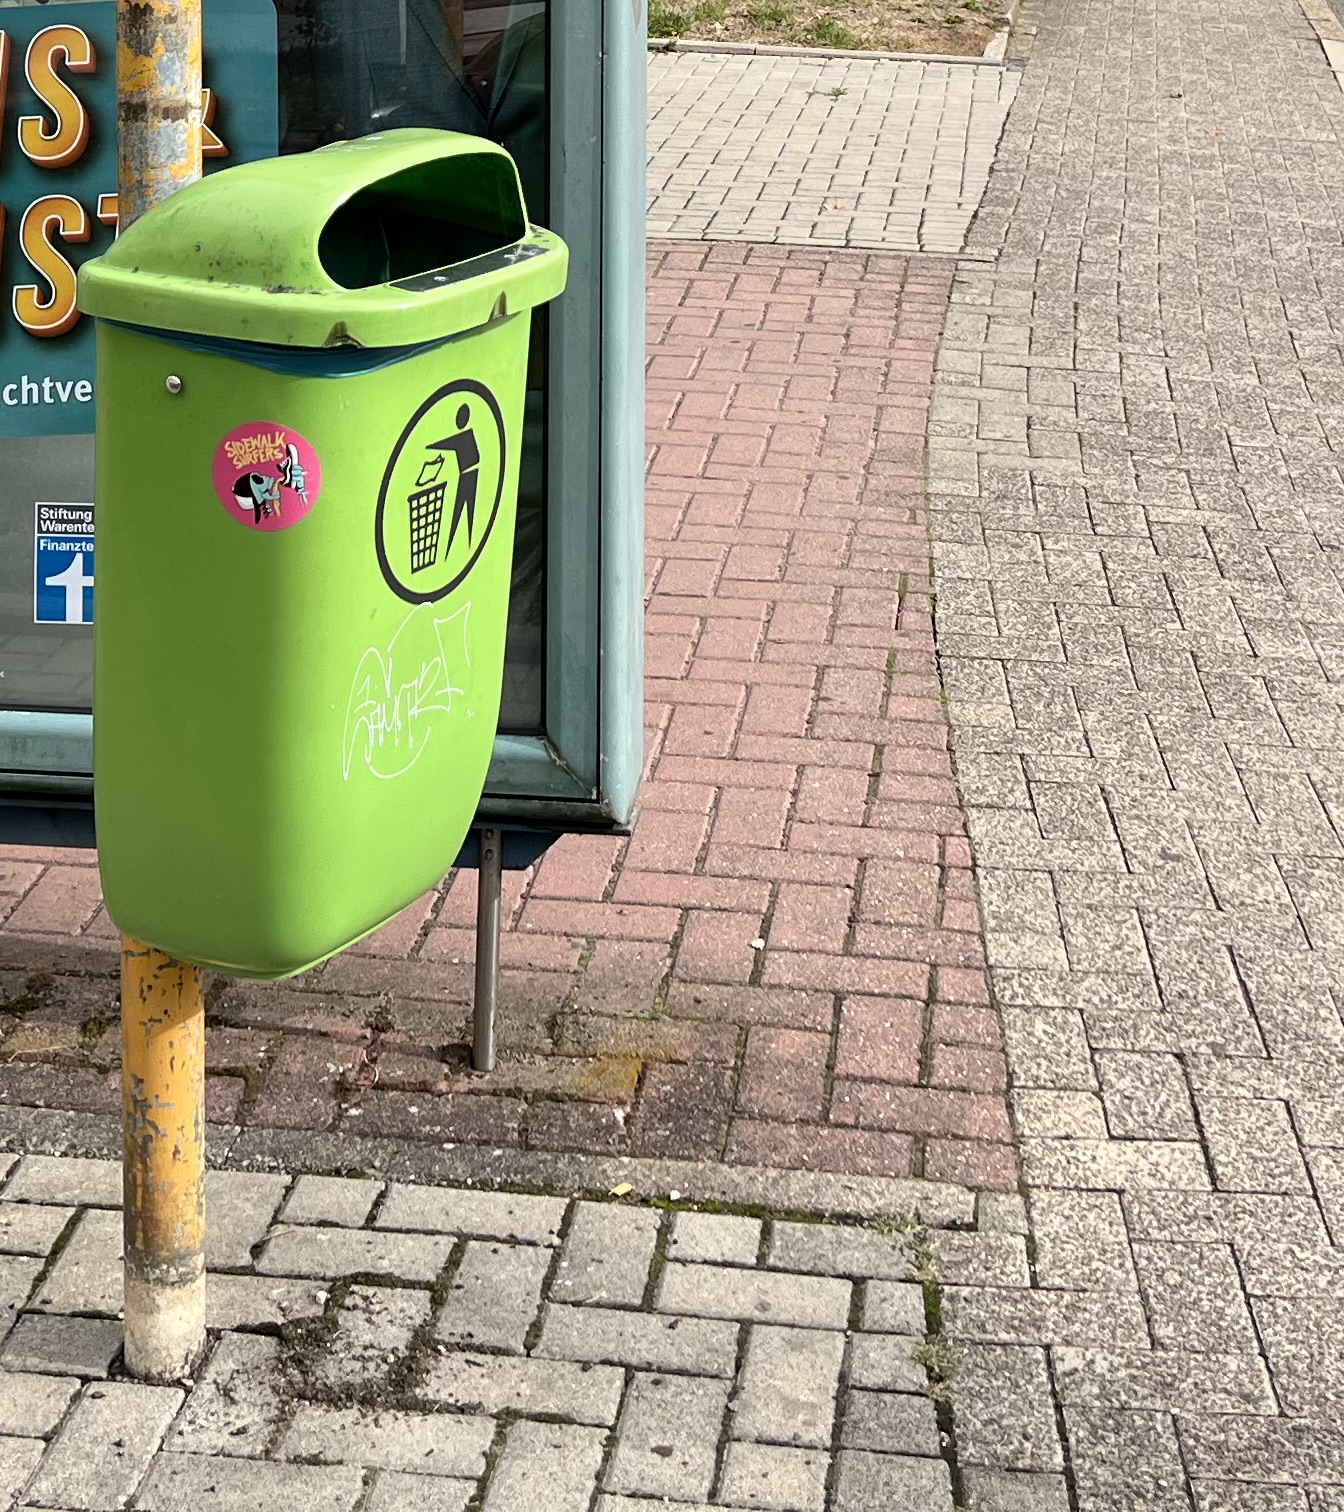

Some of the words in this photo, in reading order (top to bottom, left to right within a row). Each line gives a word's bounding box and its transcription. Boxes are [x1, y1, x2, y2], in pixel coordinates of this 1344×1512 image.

[224, 431, 287, 459] SIDEWALK
[232, 448, 284, 470] SURFERS
[40, 507, 93, 522] Stiftung
[40, 520, 95, 533] Warente
[39, 538, 95, 552] Finanzte
